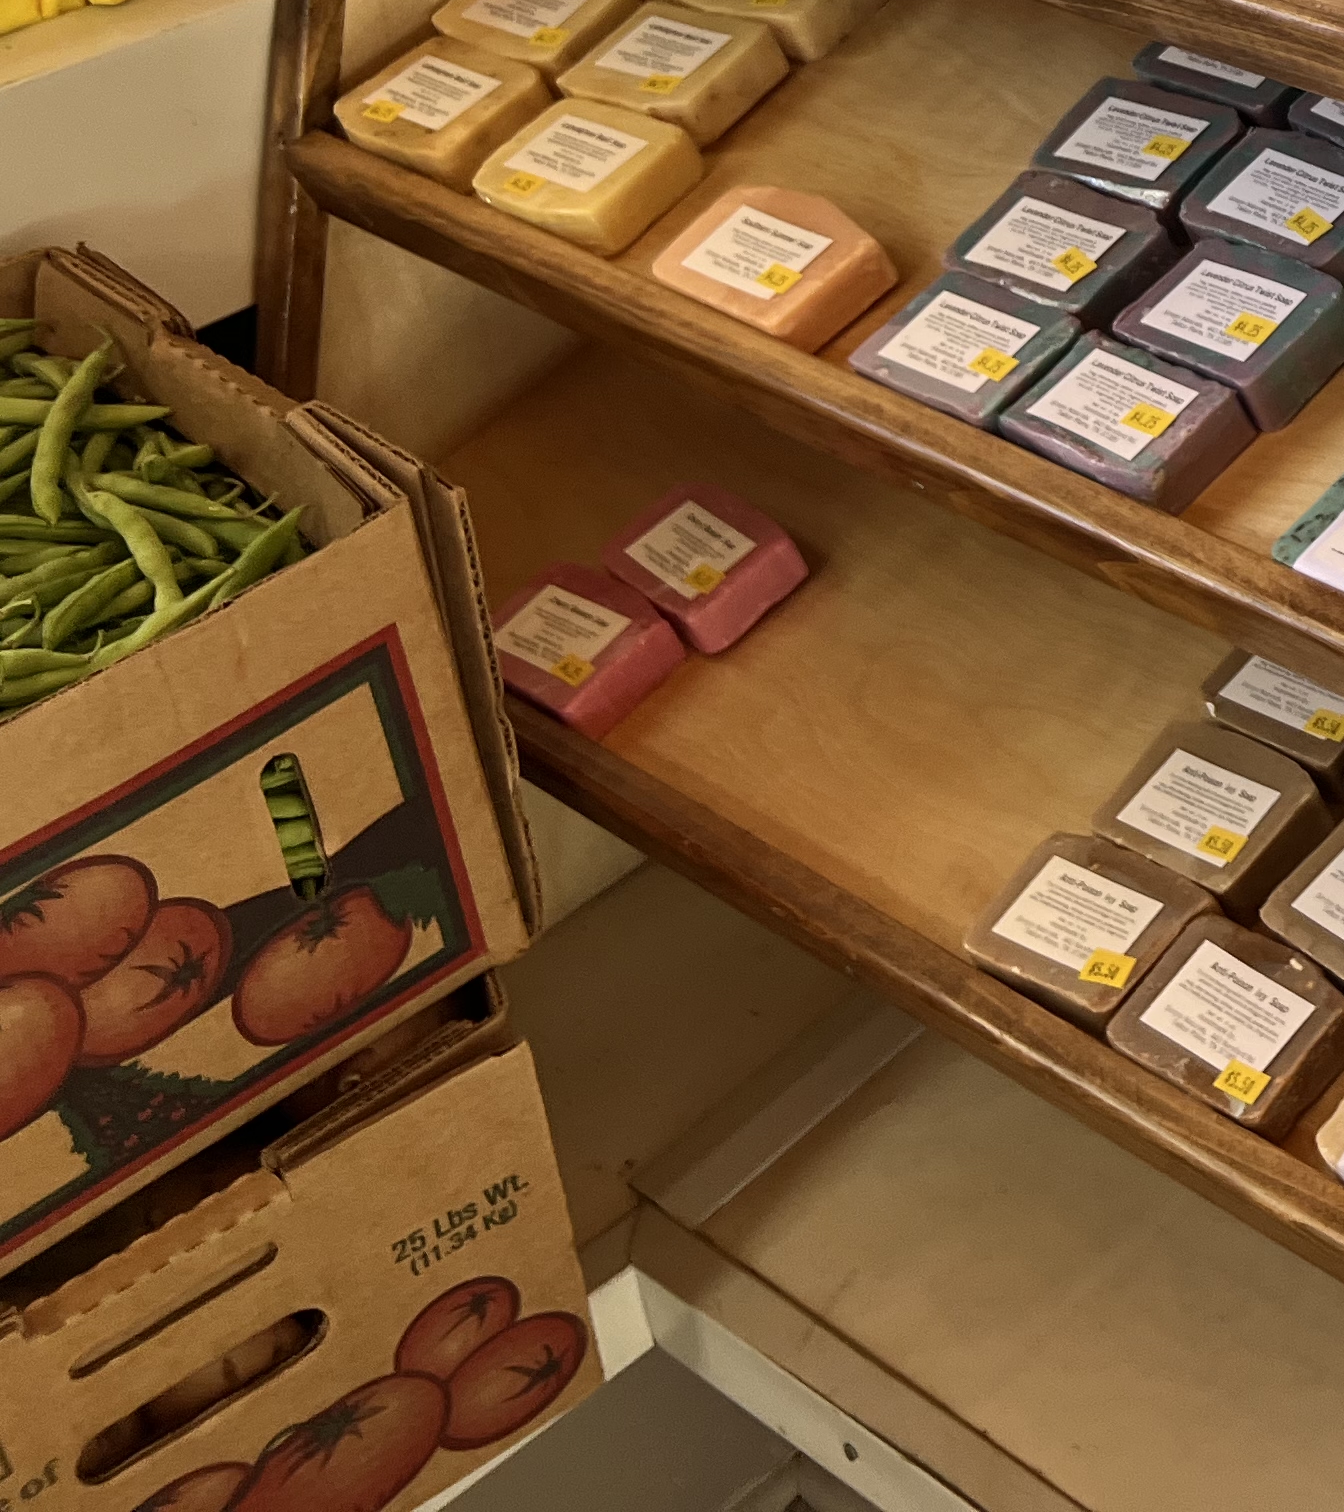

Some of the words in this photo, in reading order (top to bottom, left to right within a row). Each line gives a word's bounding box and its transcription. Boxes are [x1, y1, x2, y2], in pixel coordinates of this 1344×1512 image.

[392, 1228, 426, 1264] 25
[433, 1202, 478, 1239] Lbs
[483, 1174, 530, 1206] Wt.
[410, 1223, 478, 1276] (11.34
